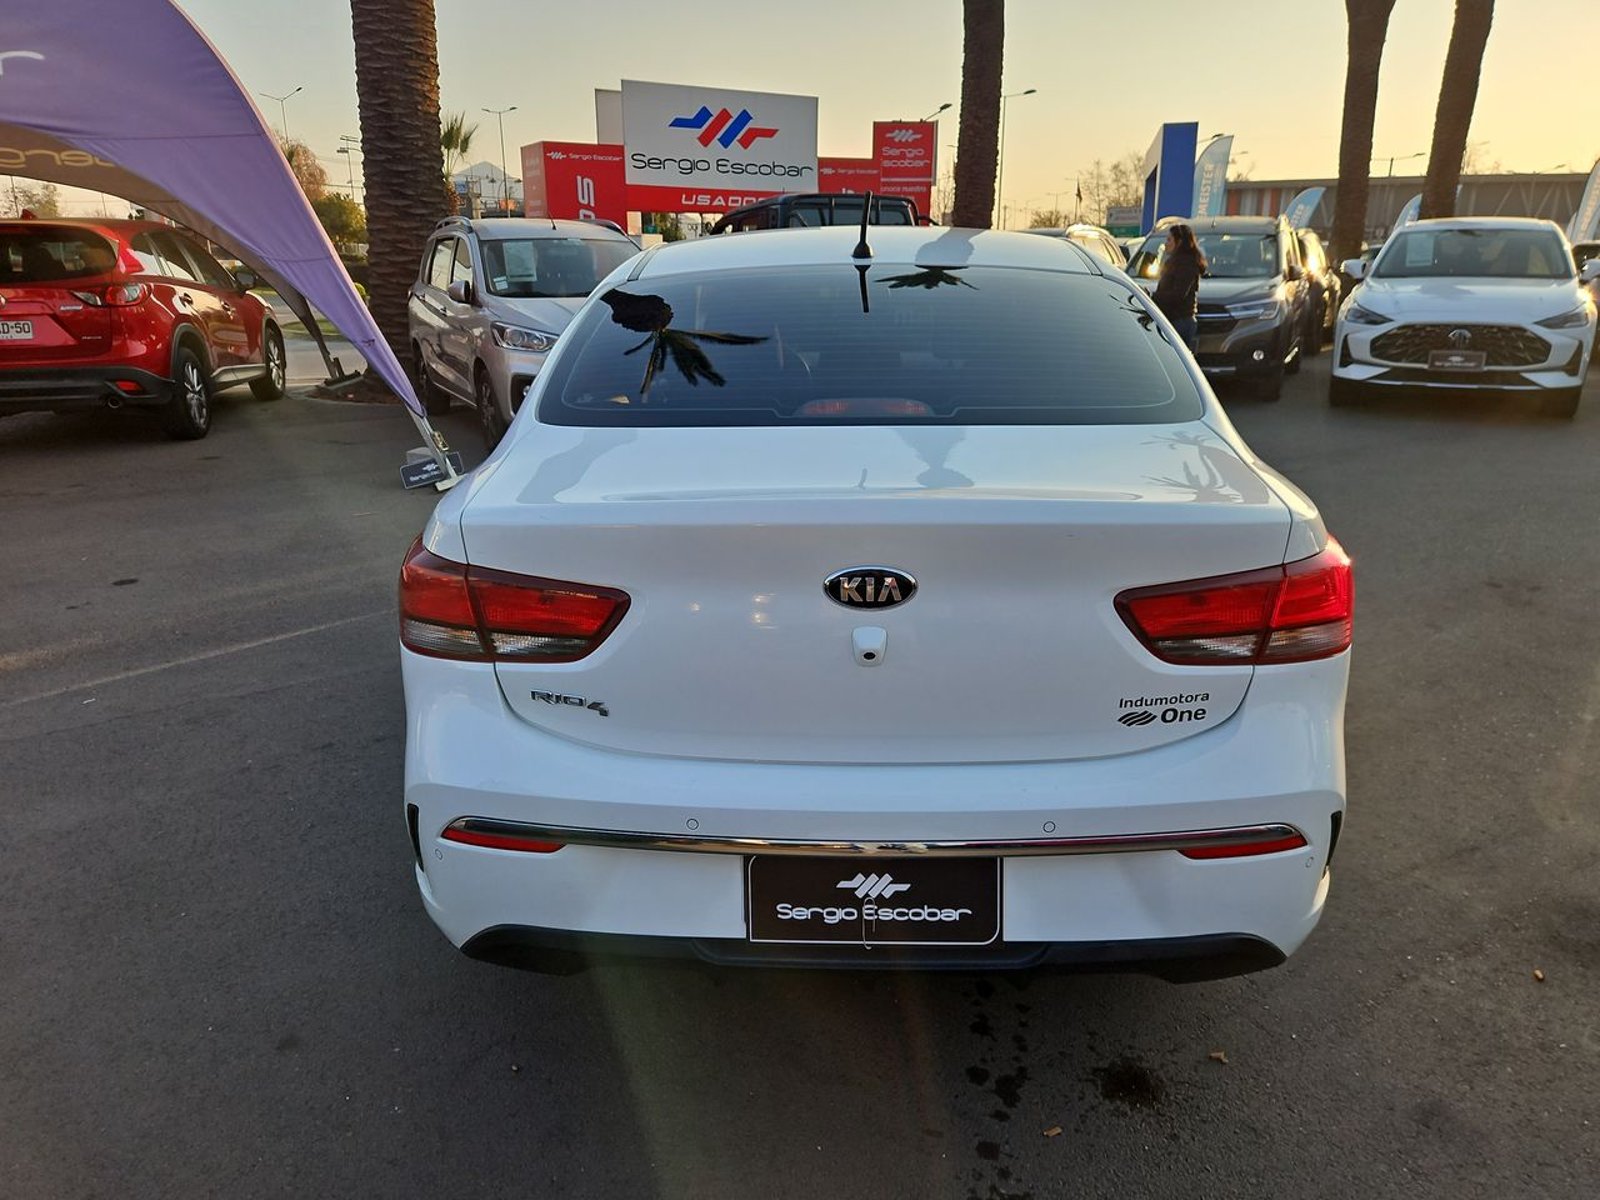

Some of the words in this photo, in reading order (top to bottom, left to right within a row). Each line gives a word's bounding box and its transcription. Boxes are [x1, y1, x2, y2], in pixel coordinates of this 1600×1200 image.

[631, 153, 711, 175] Sergio
[716, 158, 813, 177] Escobar
[839, 577, 902, 602] KIA
[1119, 692, 1210, 709] Indumotora
[1161, 707, 1207, 724] One
[776, 903, 858, 924] Sergio
[863, 904, 973, 922] Escobar
